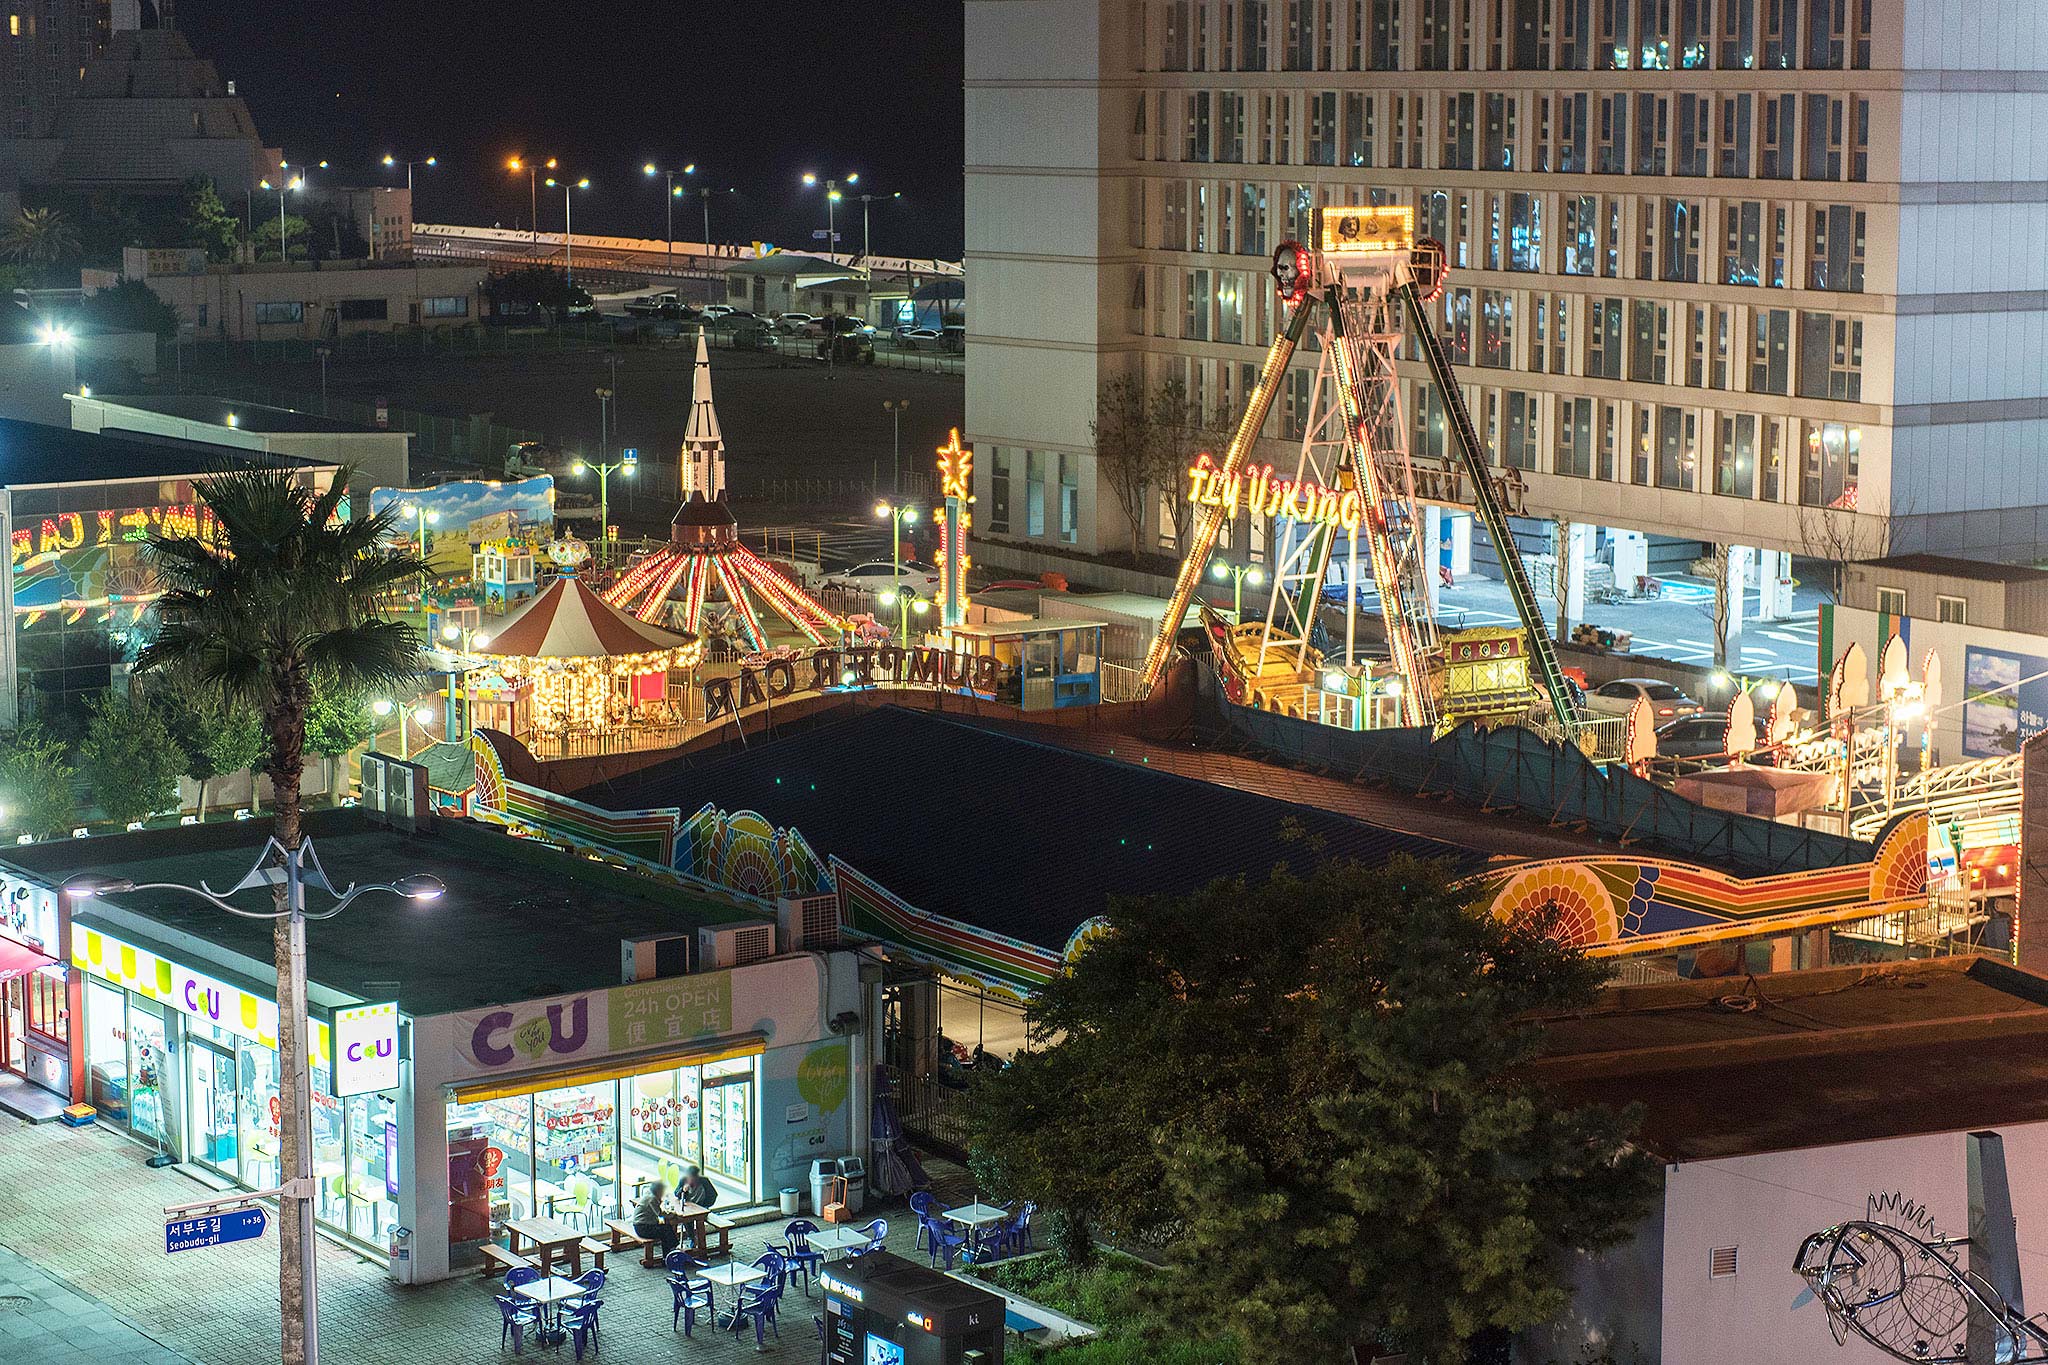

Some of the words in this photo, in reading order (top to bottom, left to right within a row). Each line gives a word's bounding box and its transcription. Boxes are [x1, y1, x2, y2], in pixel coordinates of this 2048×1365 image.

[185, 980, 219, 1020] CU
[624, 998, 659, 1018] 24h
[666, 987, 720, 1011] OPEN
[471, 997, 588, 1066] CU
[347, 1038, 391, 1062] CU
[809, 1135, 825, 1145] CU
[169, 1218, 221, 1236] 서부두길
[169, 1234, 219, 1251] Seobudu-gil
